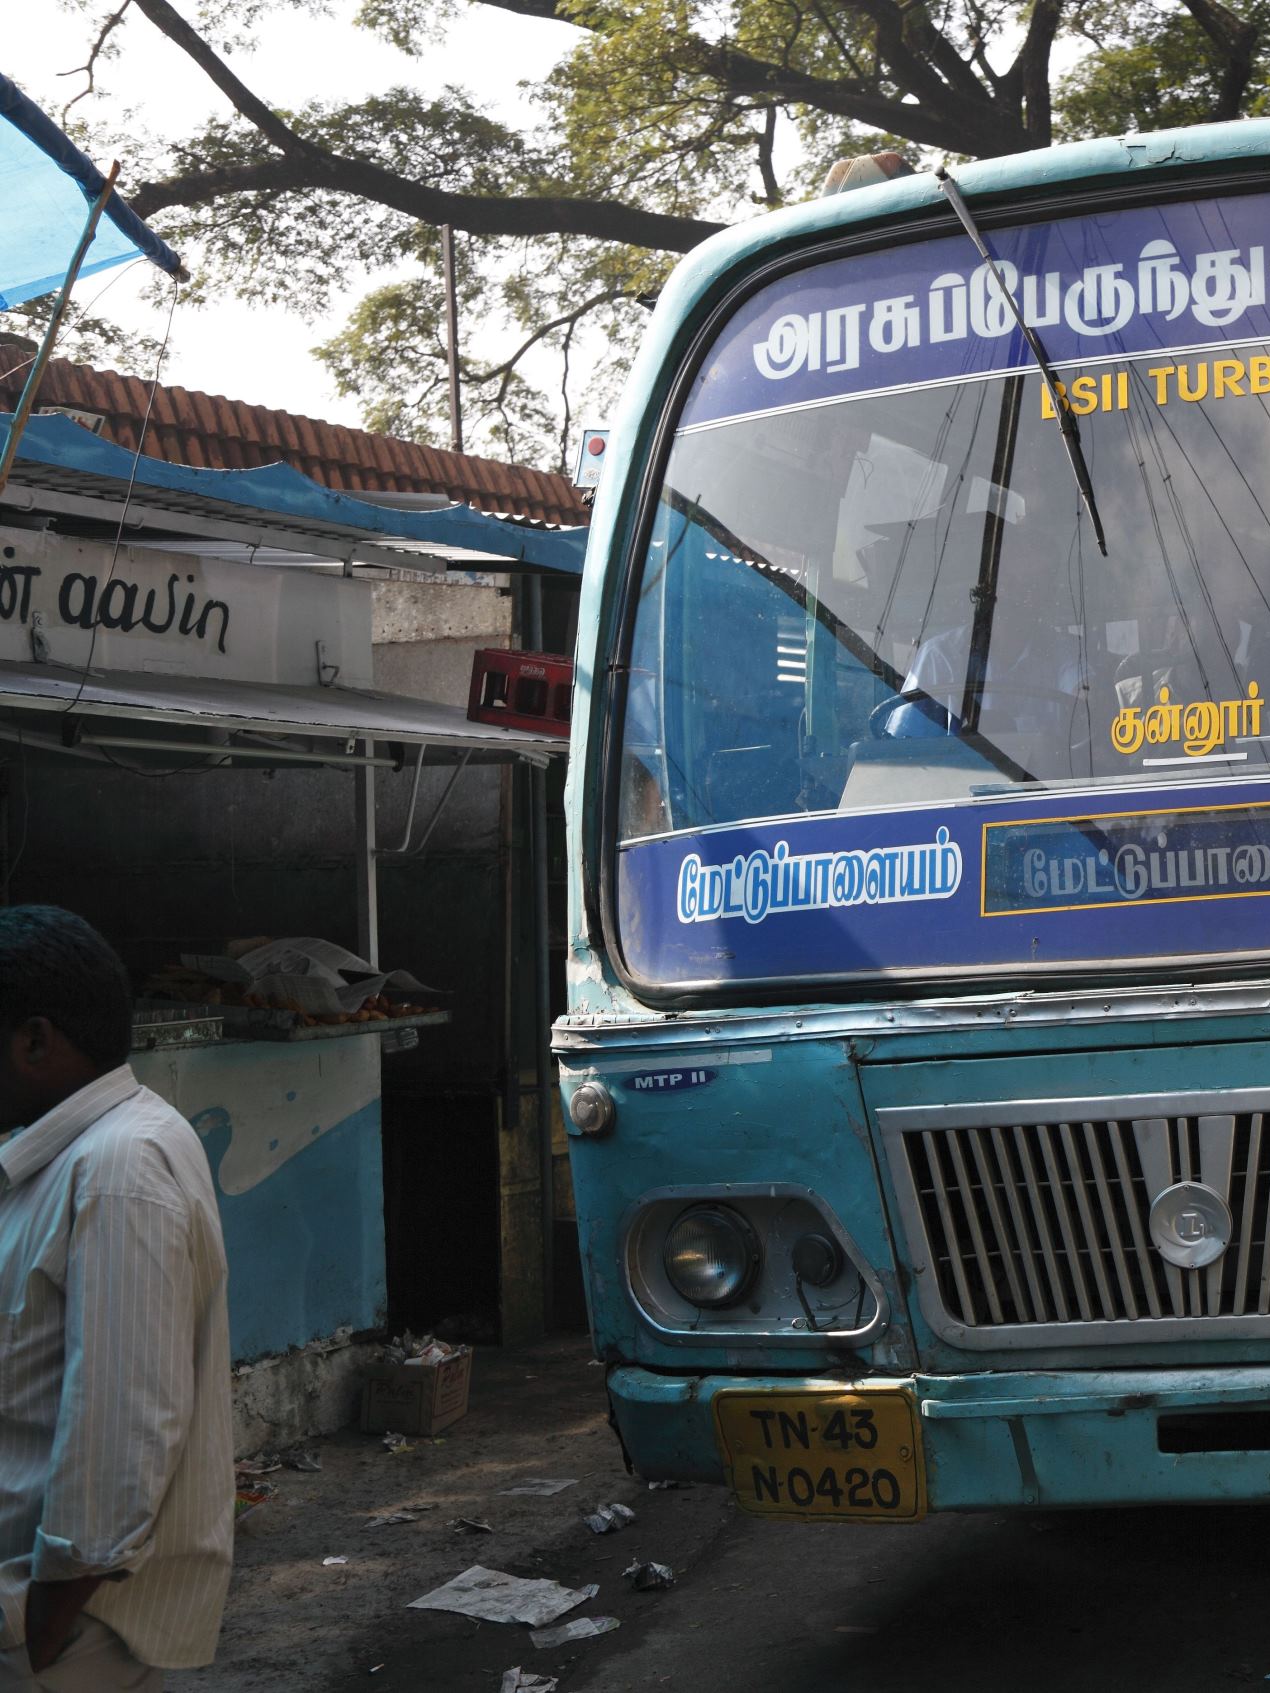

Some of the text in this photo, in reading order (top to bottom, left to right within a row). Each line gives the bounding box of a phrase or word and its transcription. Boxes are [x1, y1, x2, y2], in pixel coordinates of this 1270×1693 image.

[1041, 371, 1130, 420] BSII
[1111, 680, 1265, 757] குன்னூர்
[677, 825, 963, 924] மேட்டுப்பாளையம்
[634, 1070, 706, 1090] MTP II
